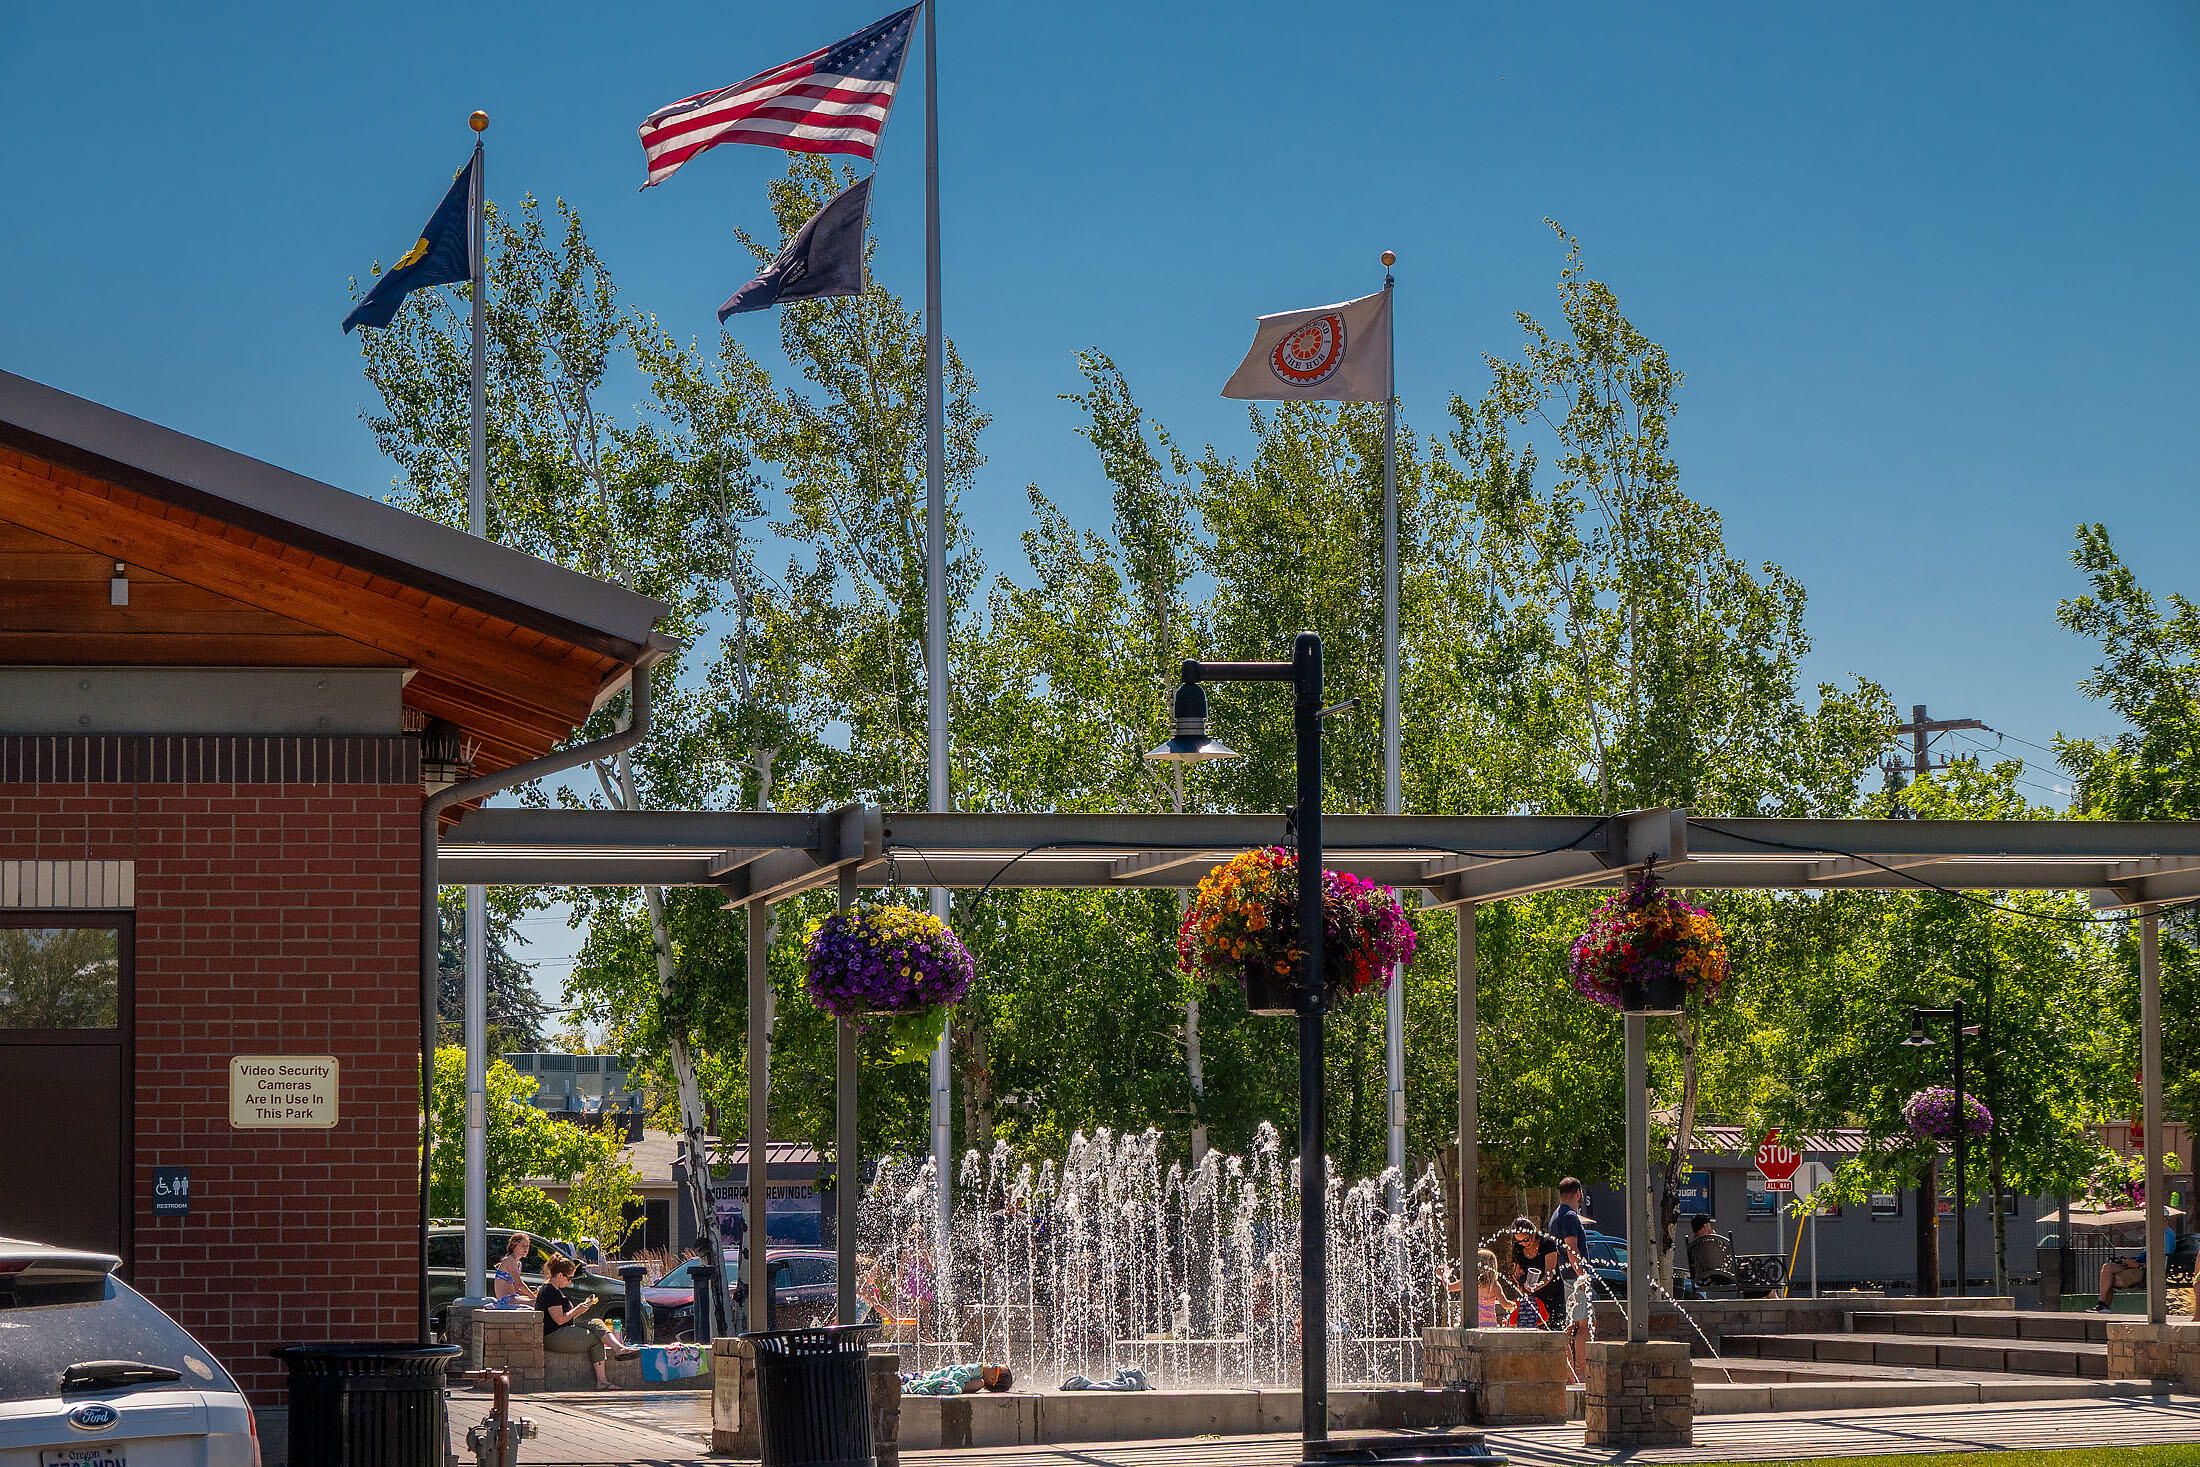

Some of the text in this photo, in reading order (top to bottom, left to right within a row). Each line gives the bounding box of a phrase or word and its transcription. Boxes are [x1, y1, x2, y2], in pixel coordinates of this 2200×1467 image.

[1285, 353, 1326, 370] THE HUB
[240, 1065, 330, 1078] Video Security
[257, 1079, 312, 1090] Cameras
[245, 1093, 324, 1104] Are In Use In
[256, 1108, 314, 1119] This Park
[1758, 1144, 1798, 1164] STOP
[1766, 1182, 1791, 1190] ALL WAY
[766, 1186, 801, 1200] REWING
[1681, 1188, 1697, 1197] LIGHT
[82, 1408, 109, 1424] Ford
[69, 1450, 100, 1461] Oregon
